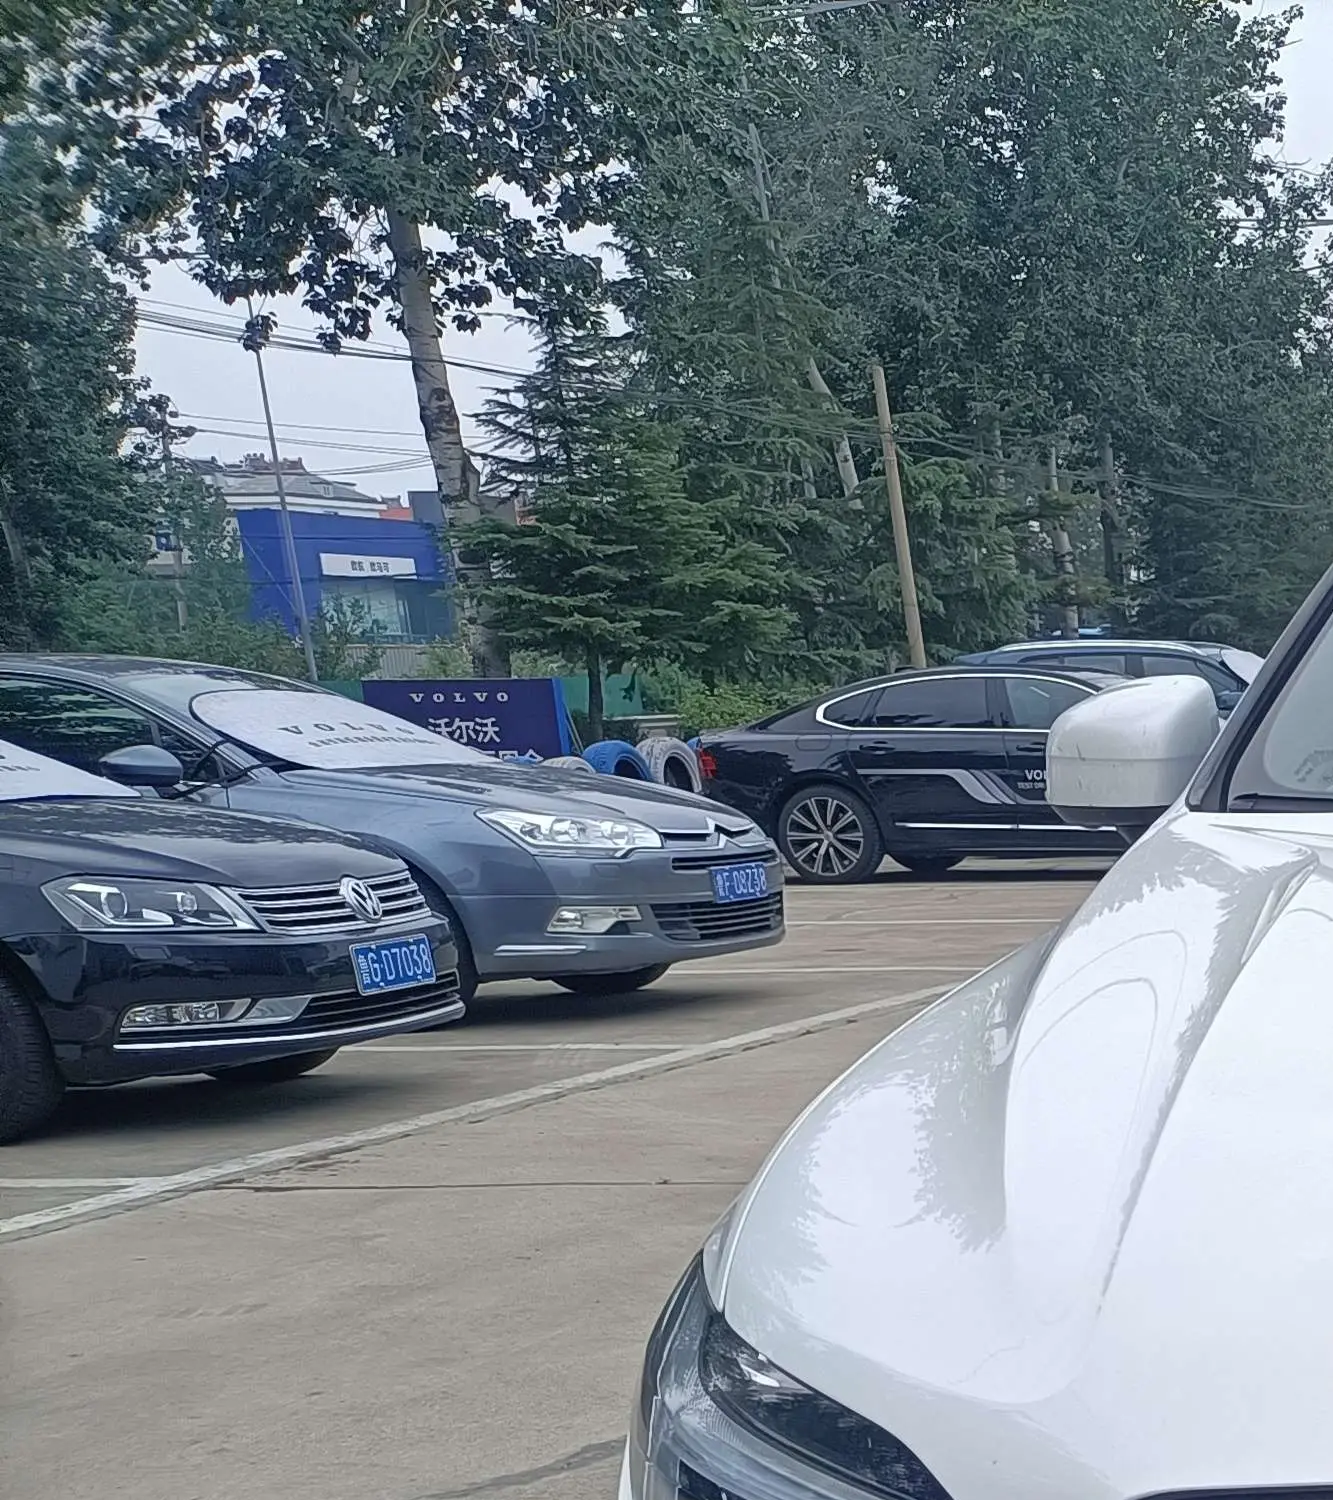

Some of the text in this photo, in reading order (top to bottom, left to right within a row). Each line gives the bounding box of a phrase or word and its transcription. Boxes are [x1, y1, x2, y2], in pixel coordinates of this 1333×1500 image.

[409, 692, 509, 703] VOLVO
[427, 717, 501, 743] 沃尔沃
